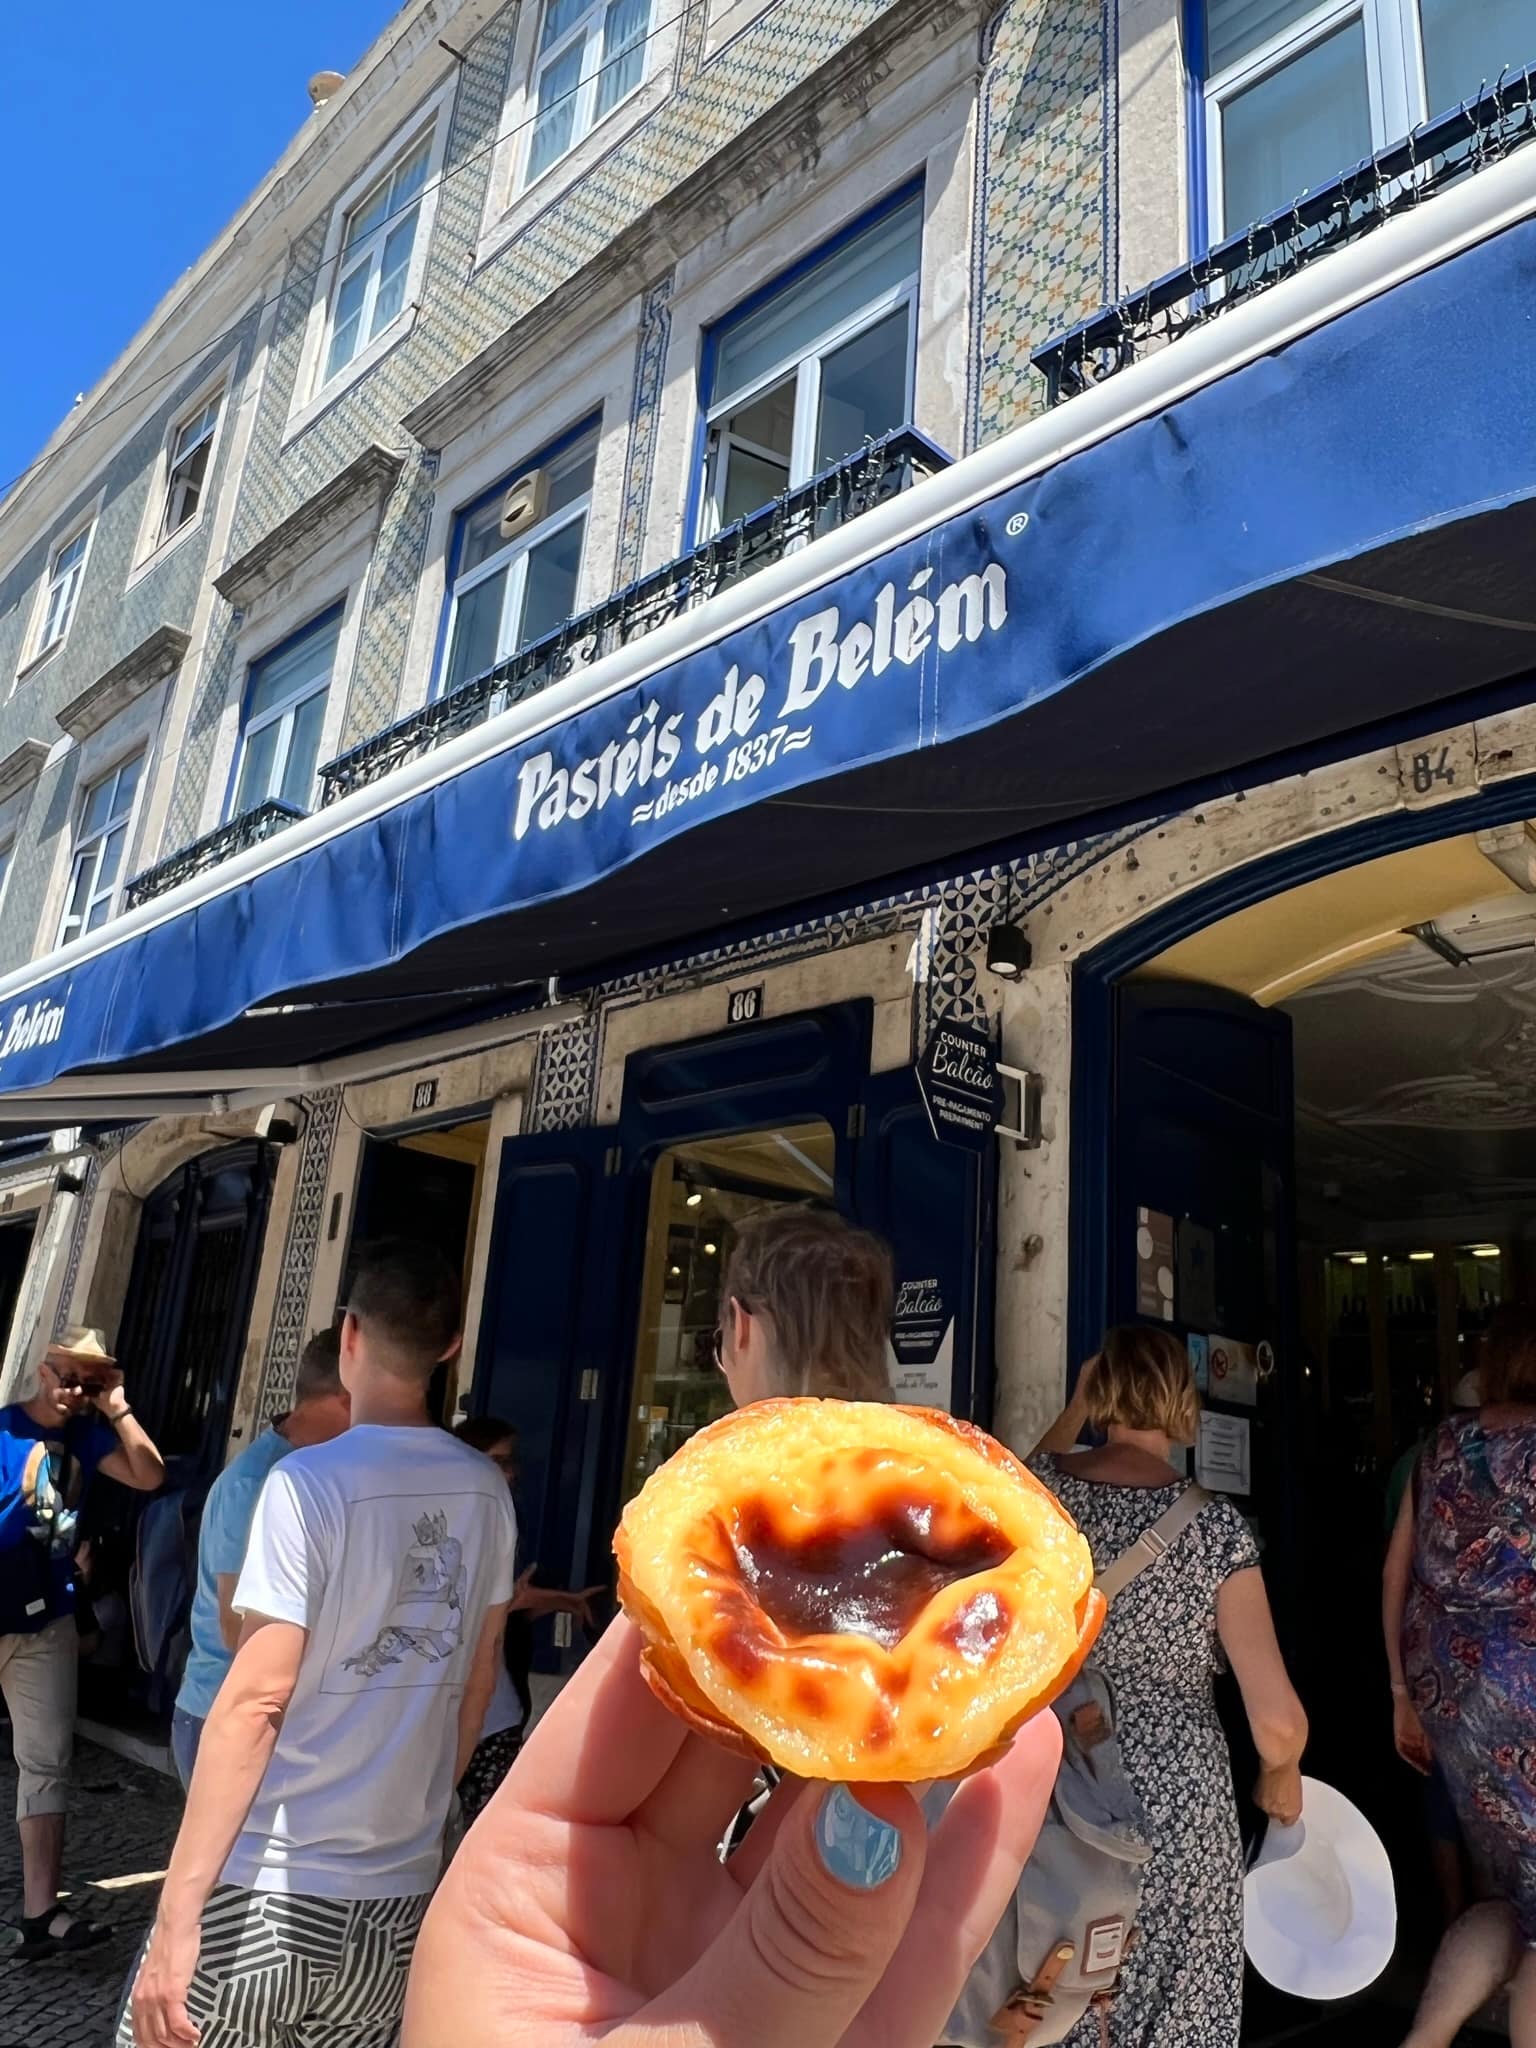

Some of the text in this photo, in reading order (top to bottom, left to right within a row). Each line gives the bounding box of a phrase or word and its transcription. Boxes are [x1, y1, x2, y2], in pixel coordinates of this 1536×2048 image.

[514, 699, 685, 841] Pastéis
[695, 664, 766, 755] de
[779, 563, 1008, 718] Belém
[654, 725, 788, 820] desde 1837
[1413, 746, 1455, 793] 84
[732, 990, 756, 1021] 86
[941, 1031, 986, 1058] COUNTER
[932, 1041, 993, 1088] Balcão
[416, 1082, 432, 1107] 88
[902, 1279, 938, 1290] COUNTER
[896, 1289, 943, 1316] Balcão
